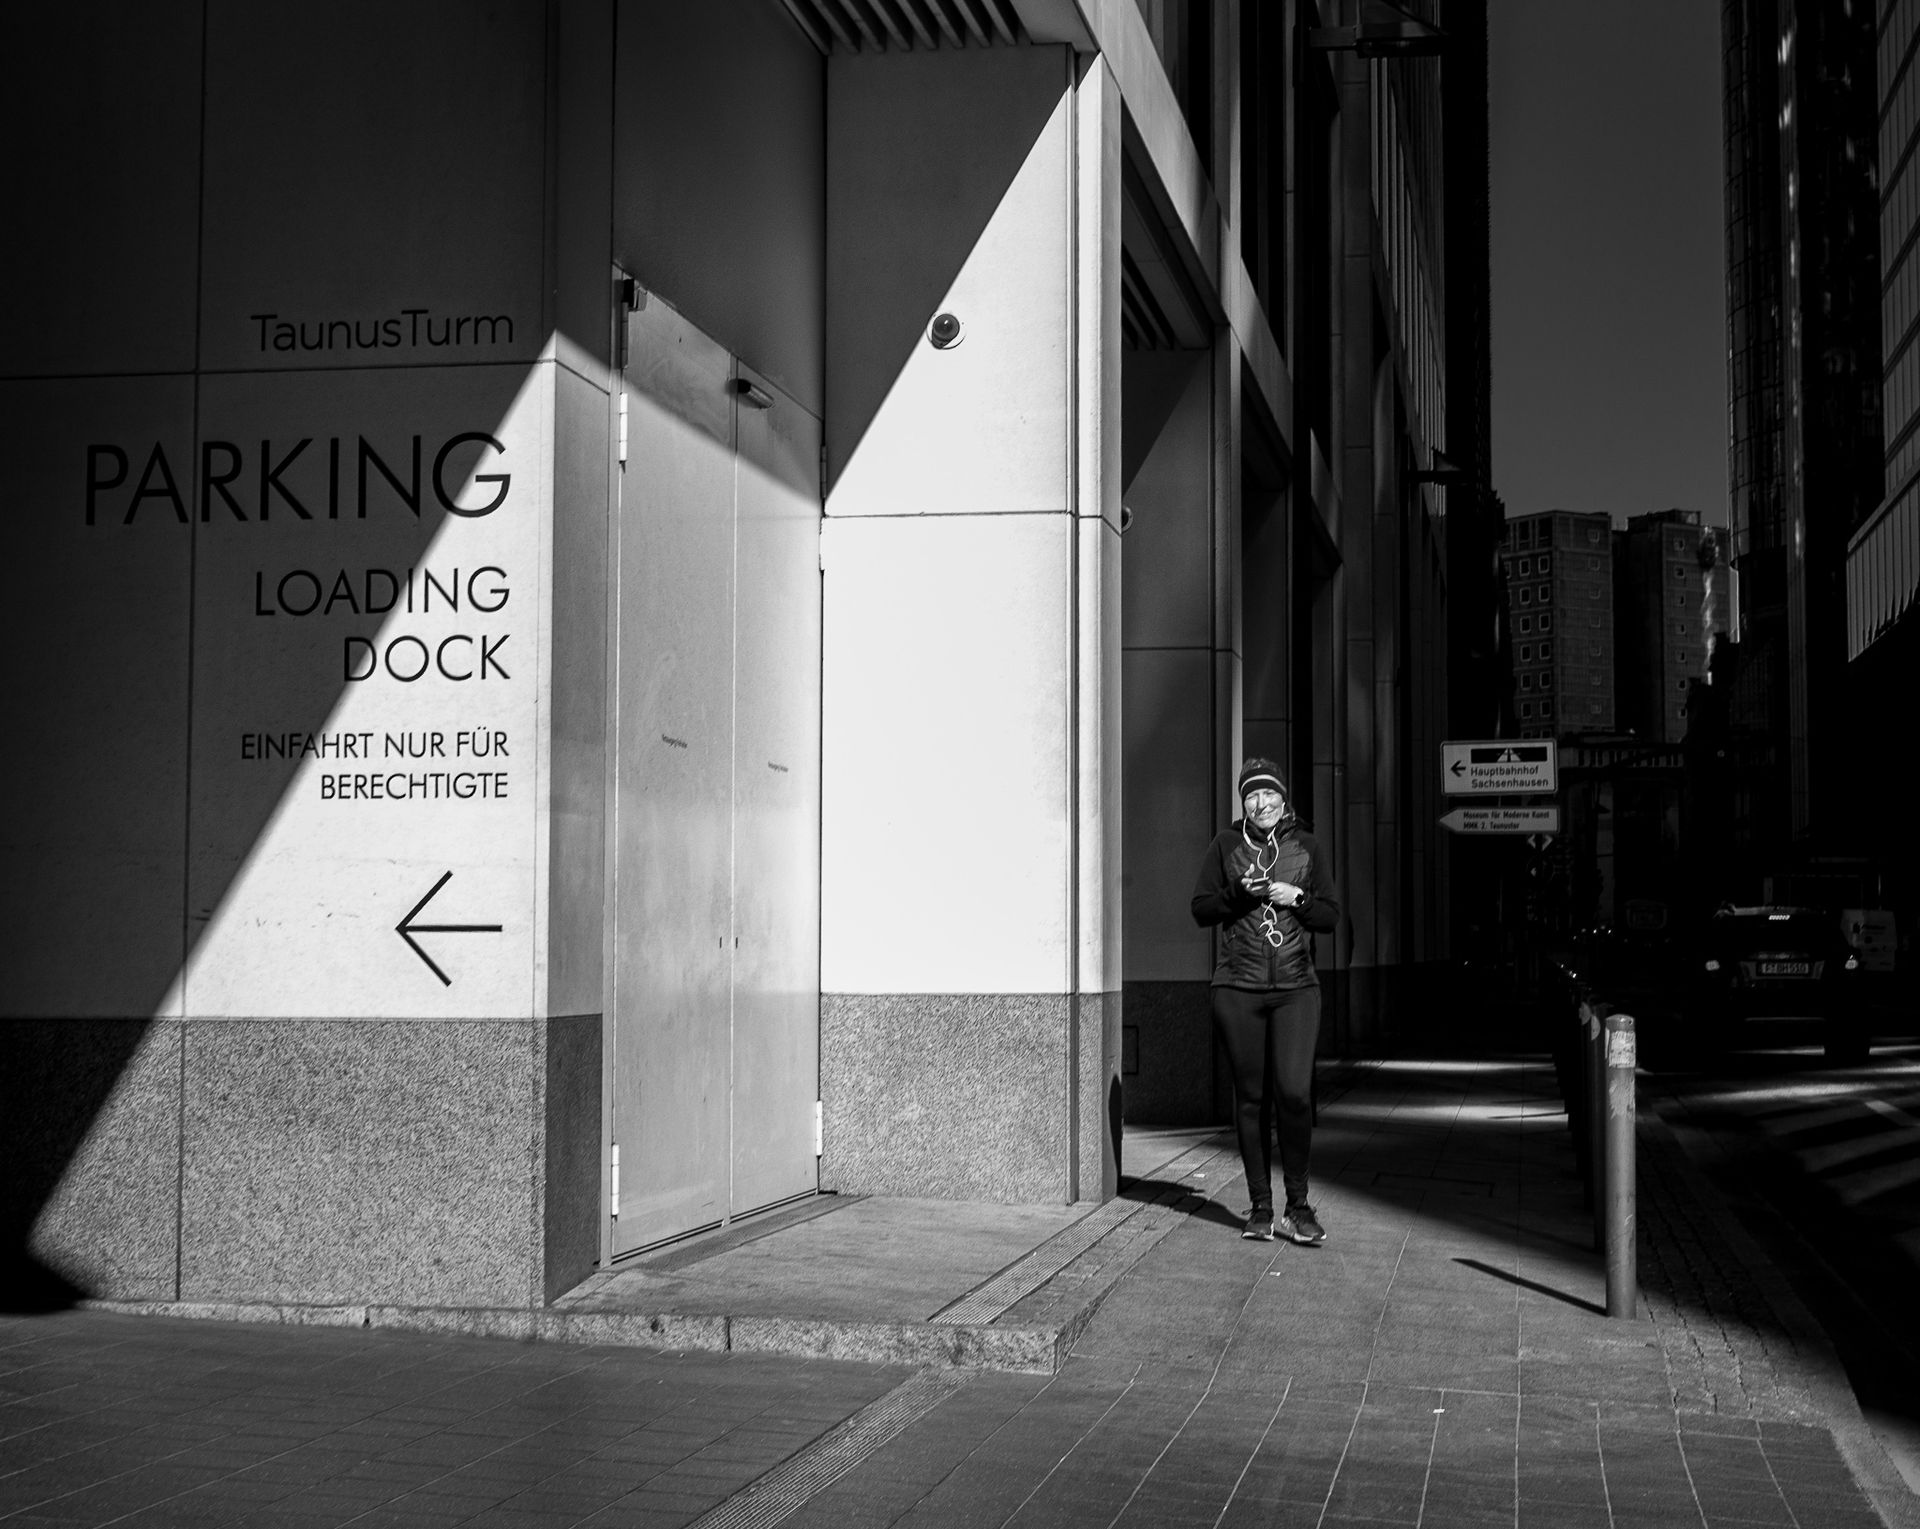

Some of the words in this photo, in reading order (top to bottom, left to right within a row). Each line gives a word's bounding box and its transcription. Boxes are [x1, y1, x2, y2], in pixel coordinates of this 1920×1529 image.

[251, 309, 513, 352] TaunusTurm
[85, 431, 511, 526] PARKING
[256, 566, 510, 616] LOADING
[343, 635, 511, 683] DOCK
[241, 732, 374, 760] EINFAHRT
[384, 732, 446, 758] NUR
[456, 726, 510, 757] FÜR
[321, 773, 509, 800] BERECHTIGTE
[1470, 766, 1539, 777] Hauptbahnhof
[1471, 778, 1549, 788] Sachsenhausen
[1463, 811, 1489, 819] Museum
[1503, 810, 1530, 818] Moderne
